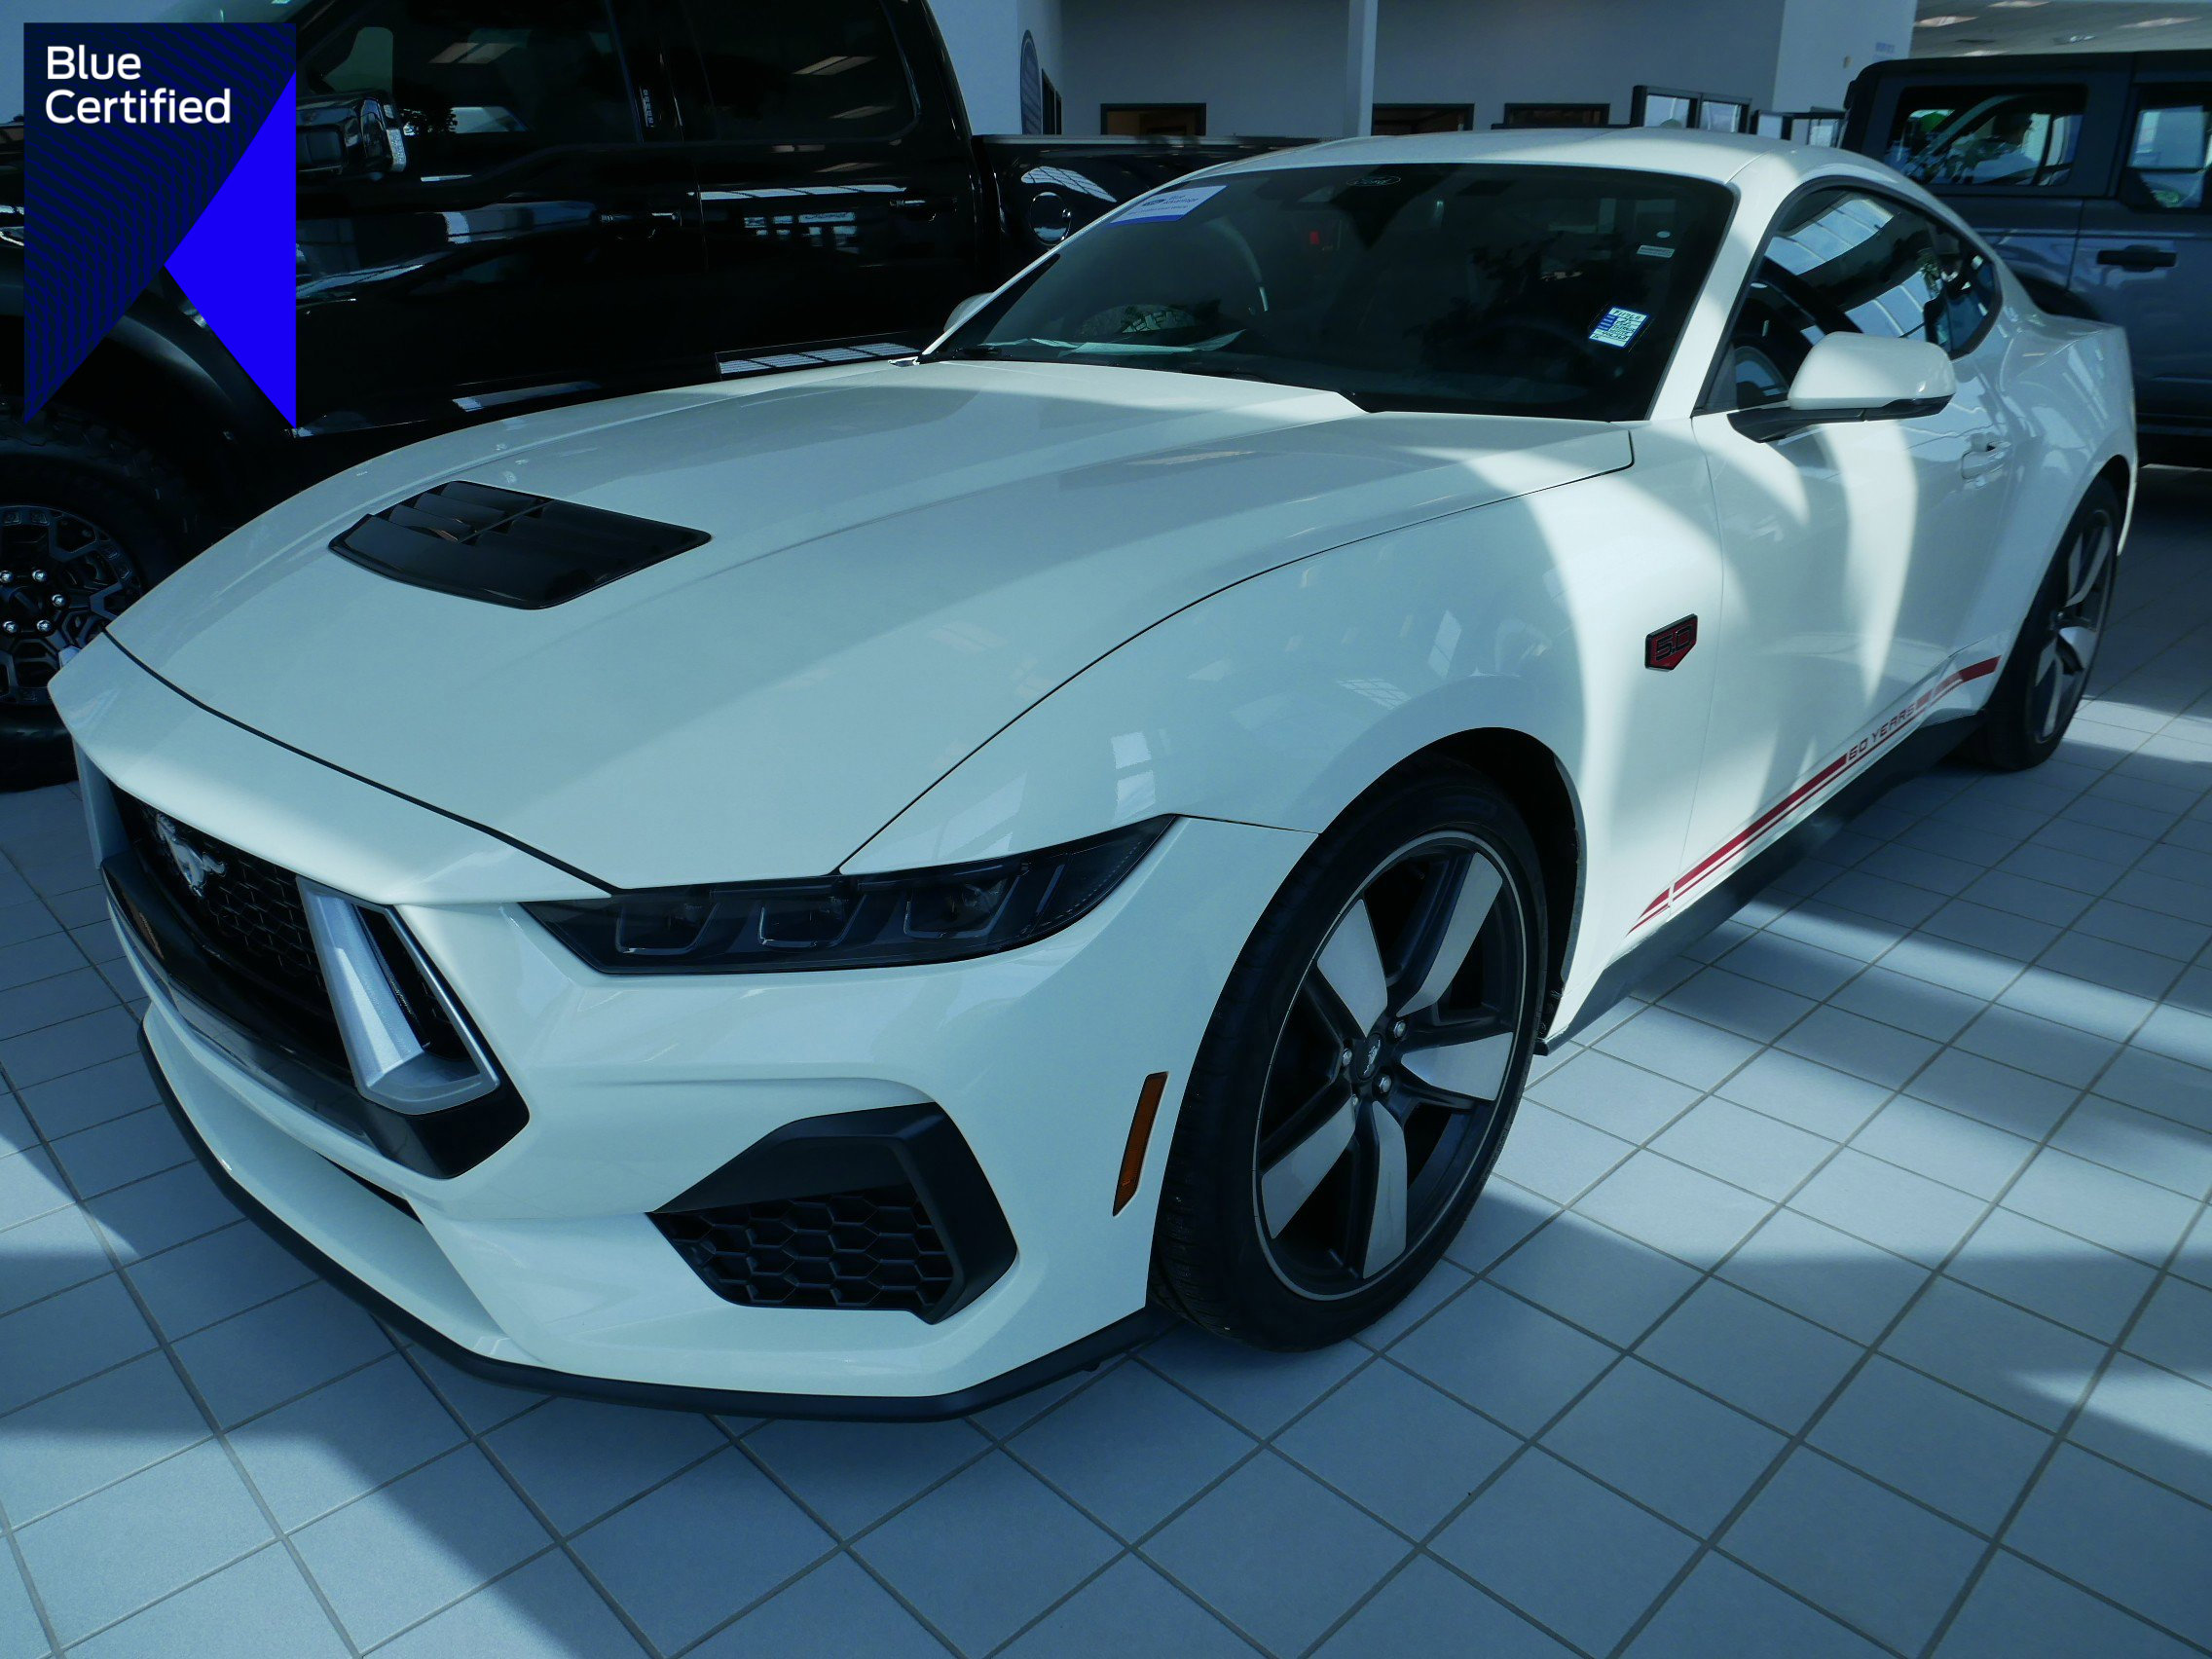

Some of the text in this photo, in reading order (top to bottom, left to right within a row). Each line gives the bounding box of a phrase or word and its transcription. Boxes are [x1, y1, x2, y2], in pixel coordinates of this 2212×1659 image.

[1656, 625, 1692, 661] 5.0
[1848, 702, 1916, 761] 60 YEARS
